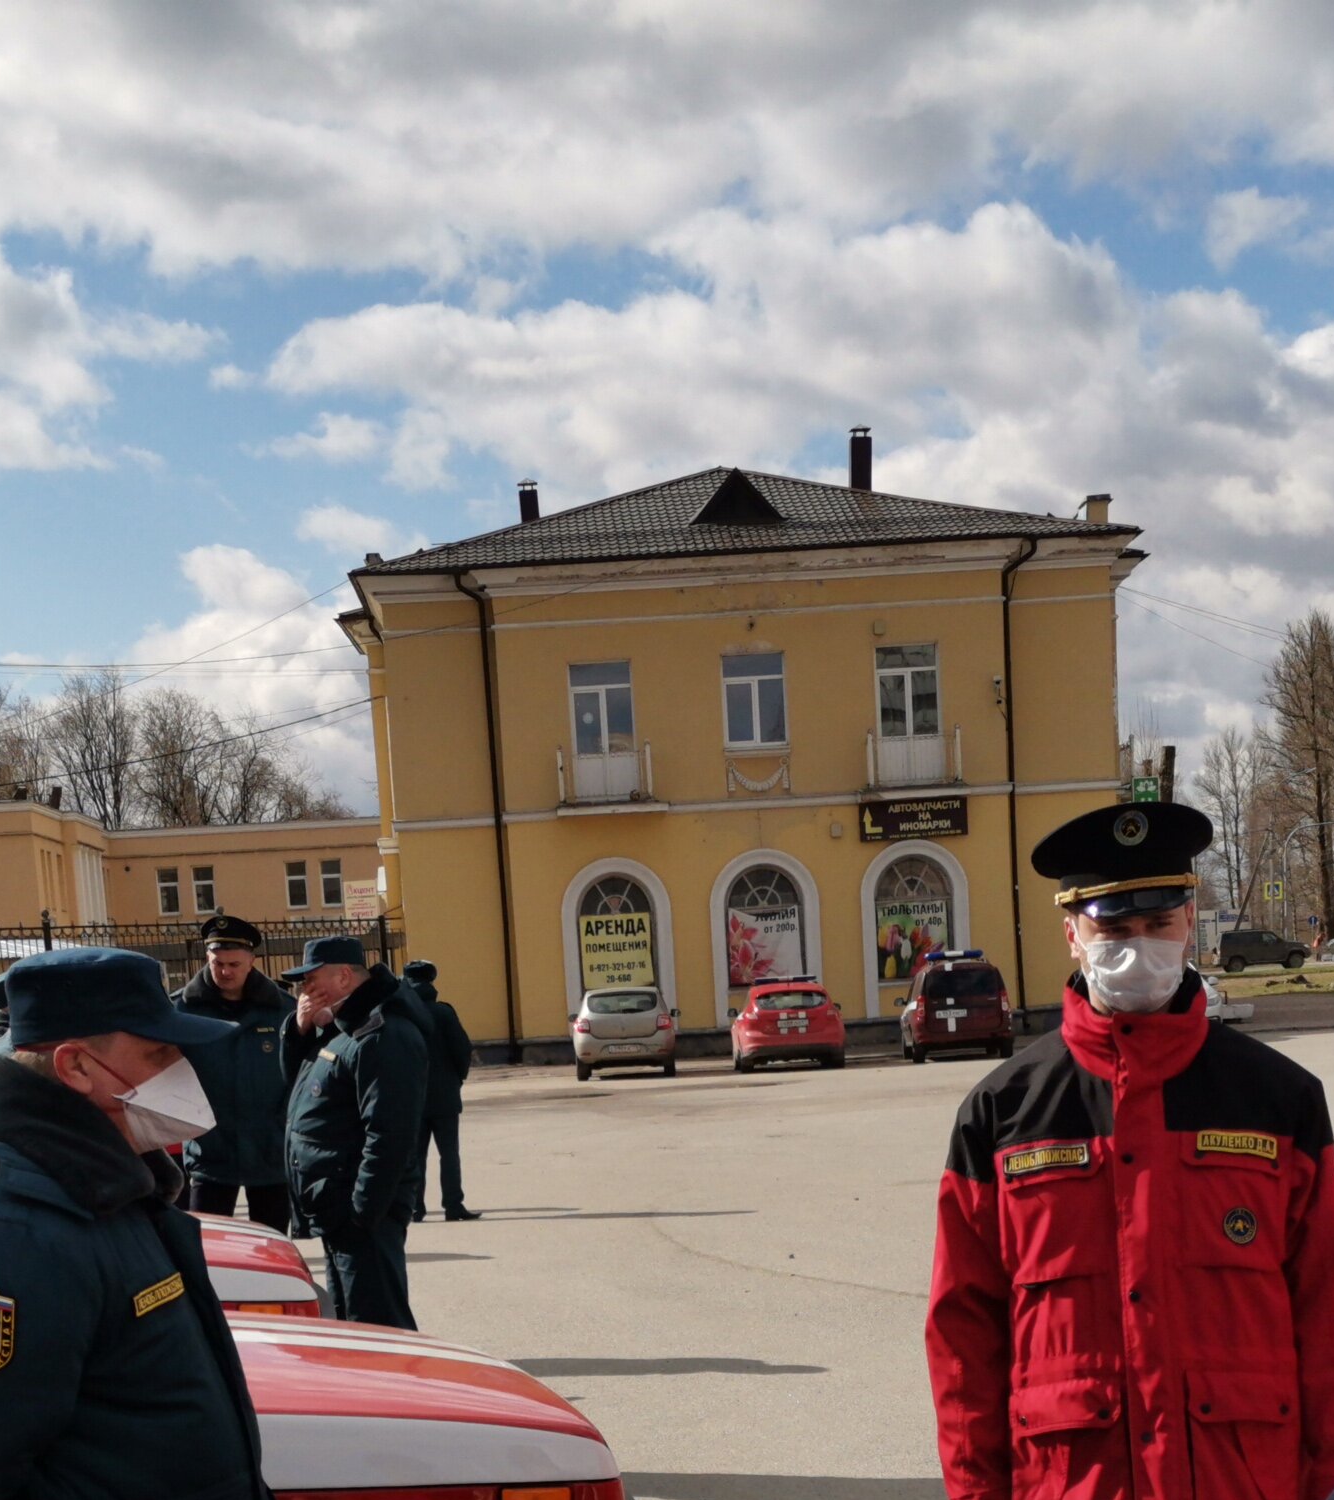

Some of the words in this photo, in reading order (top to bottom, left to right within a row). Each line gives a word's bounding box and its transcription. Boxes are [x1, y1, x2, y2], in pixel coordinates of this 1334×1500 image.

[888, 800, 961, 813] АВТОЗАПЧАСТИ
[918, 811, 932, 820] НА
[899, 819, 951, 831] ИНОМАРКИ
[585, 918, 646, 937] АРЕНДА
[585, 940, 647, 953] ПОМЕЩЕНИЯ
[1202, 1134, 1255, 1149] АКУЛЕНКО
[1008, 1147, 1084, 1171] ЛЕНОБЛПОЖСПАС
